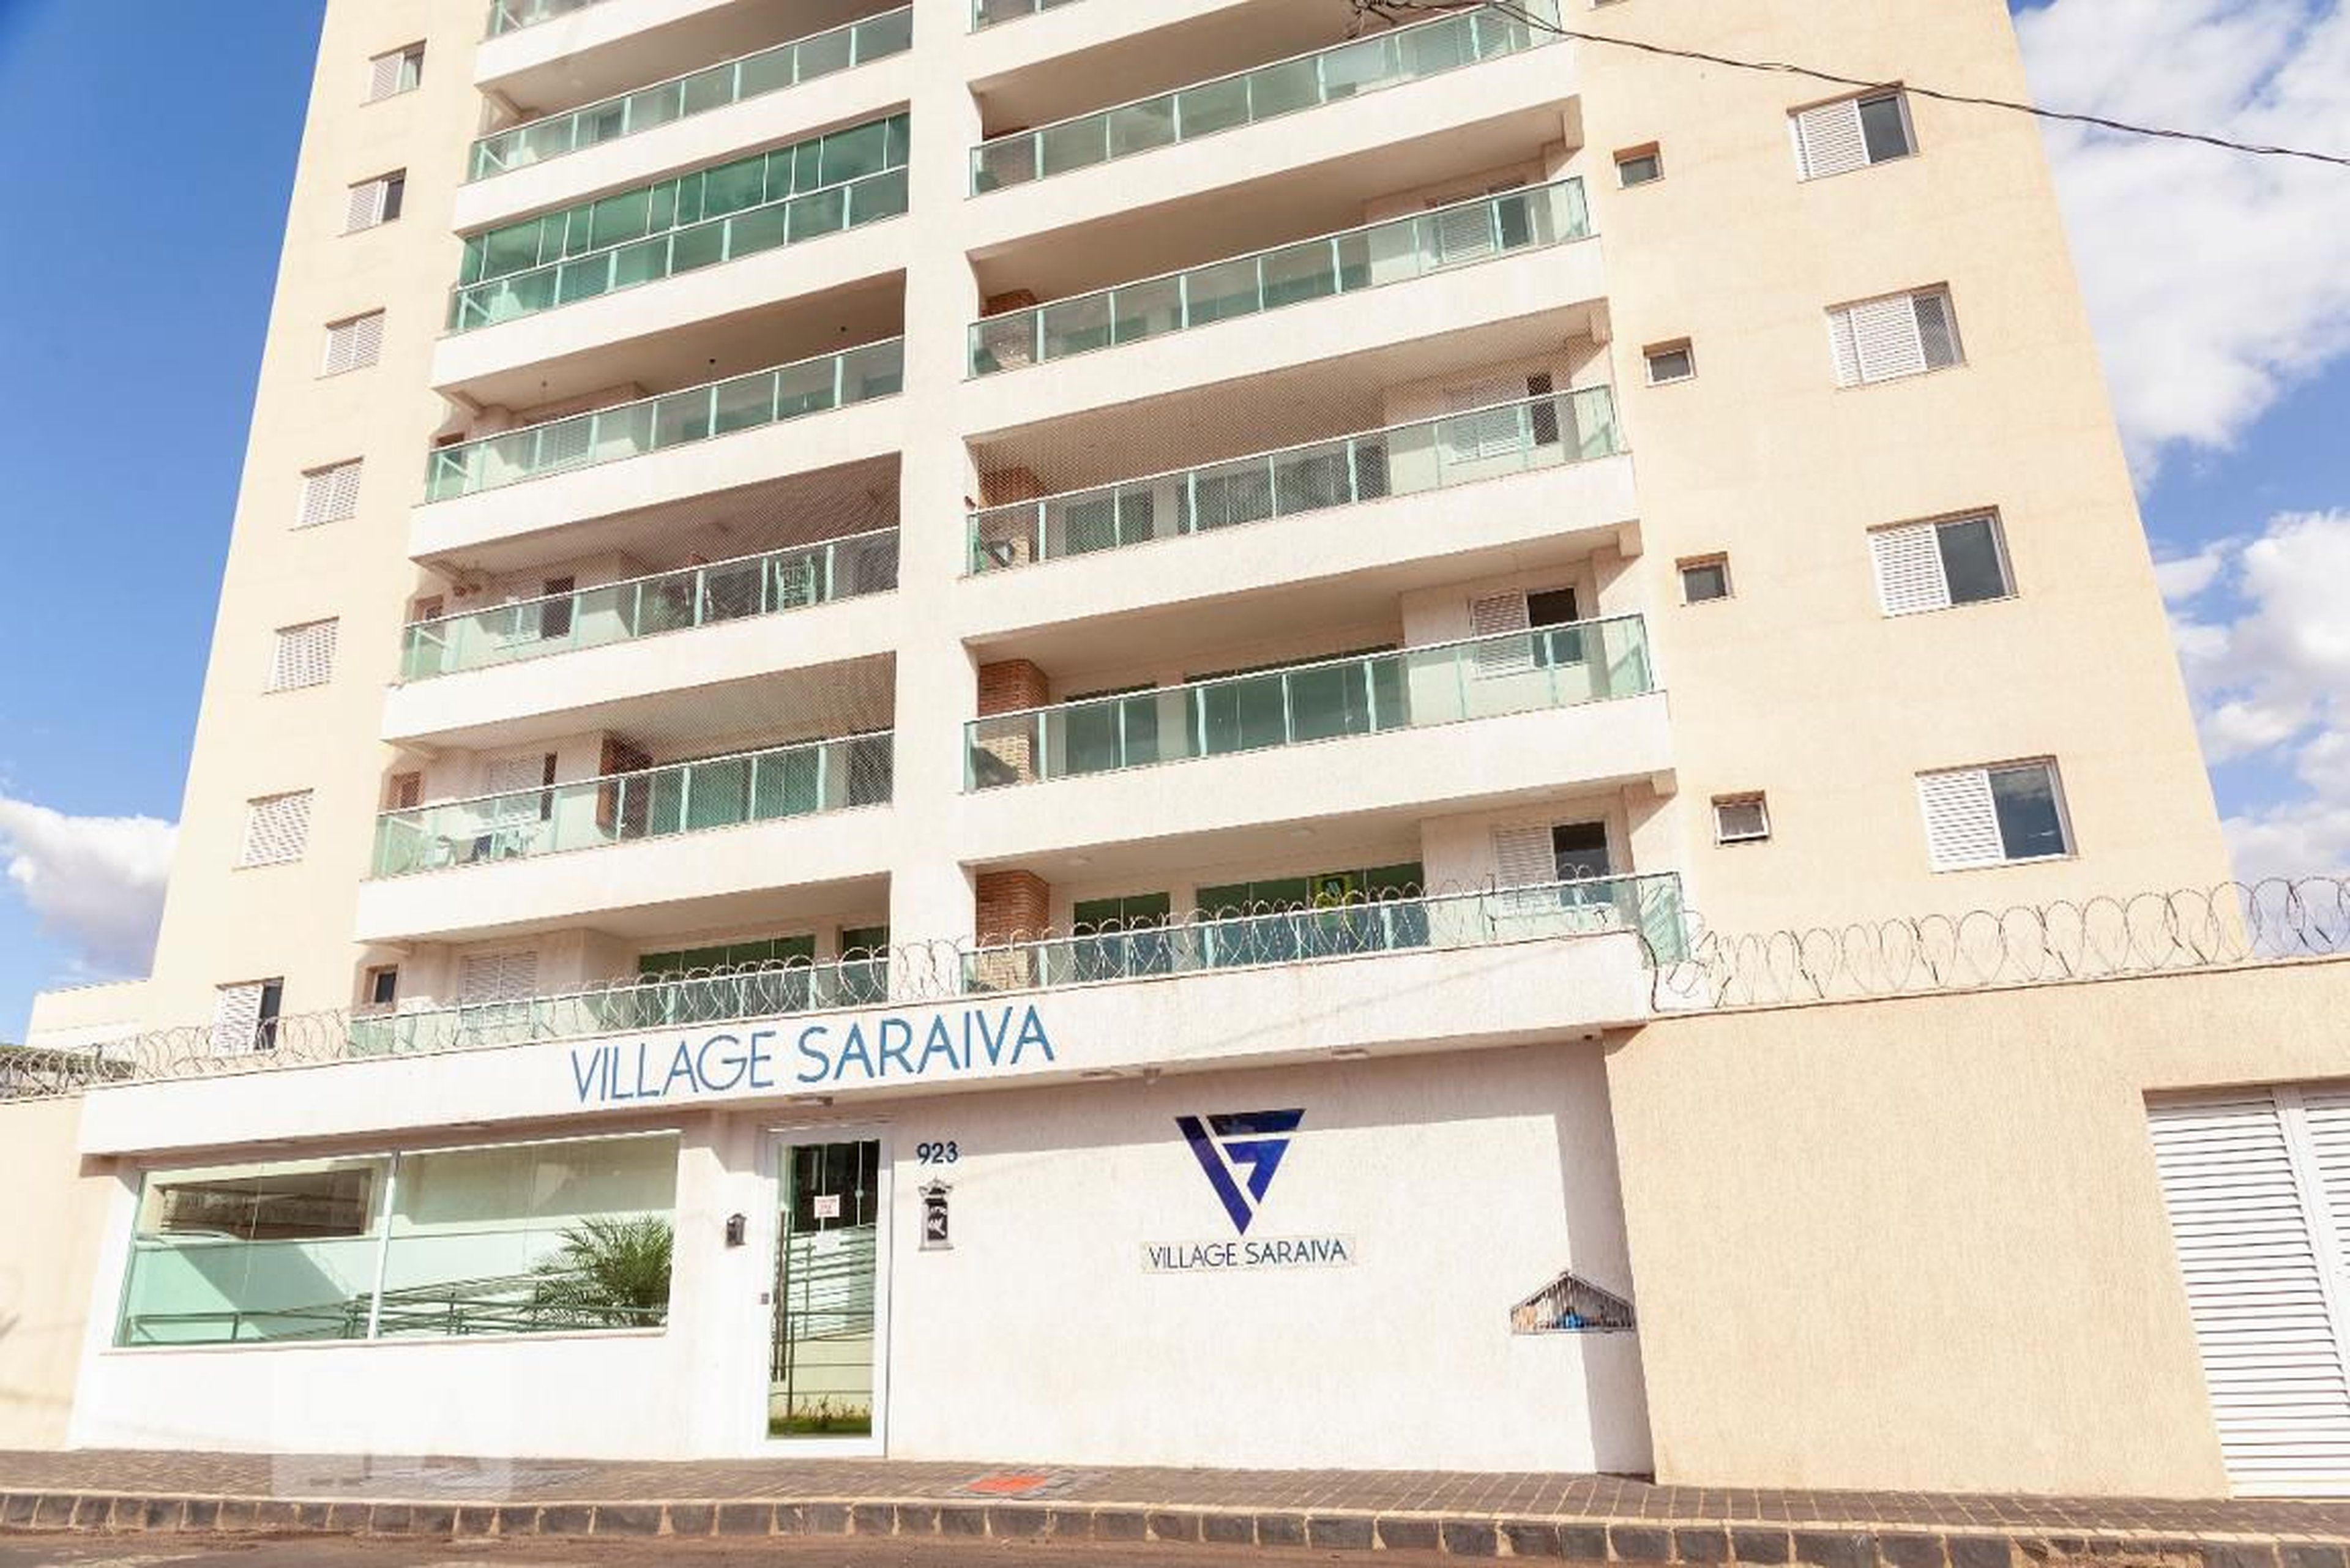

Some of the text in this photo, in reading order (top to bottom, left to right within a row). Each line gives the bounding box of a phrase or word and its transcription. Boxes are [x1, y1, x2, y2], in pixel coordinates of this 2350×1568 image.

[572, 1004, 1055, 1103] VILLAGE SARAIVA
[917, 1141, 958, 1165] 923
[1149, 1239, 1348, 1269] VILLAGE SARAIVA
